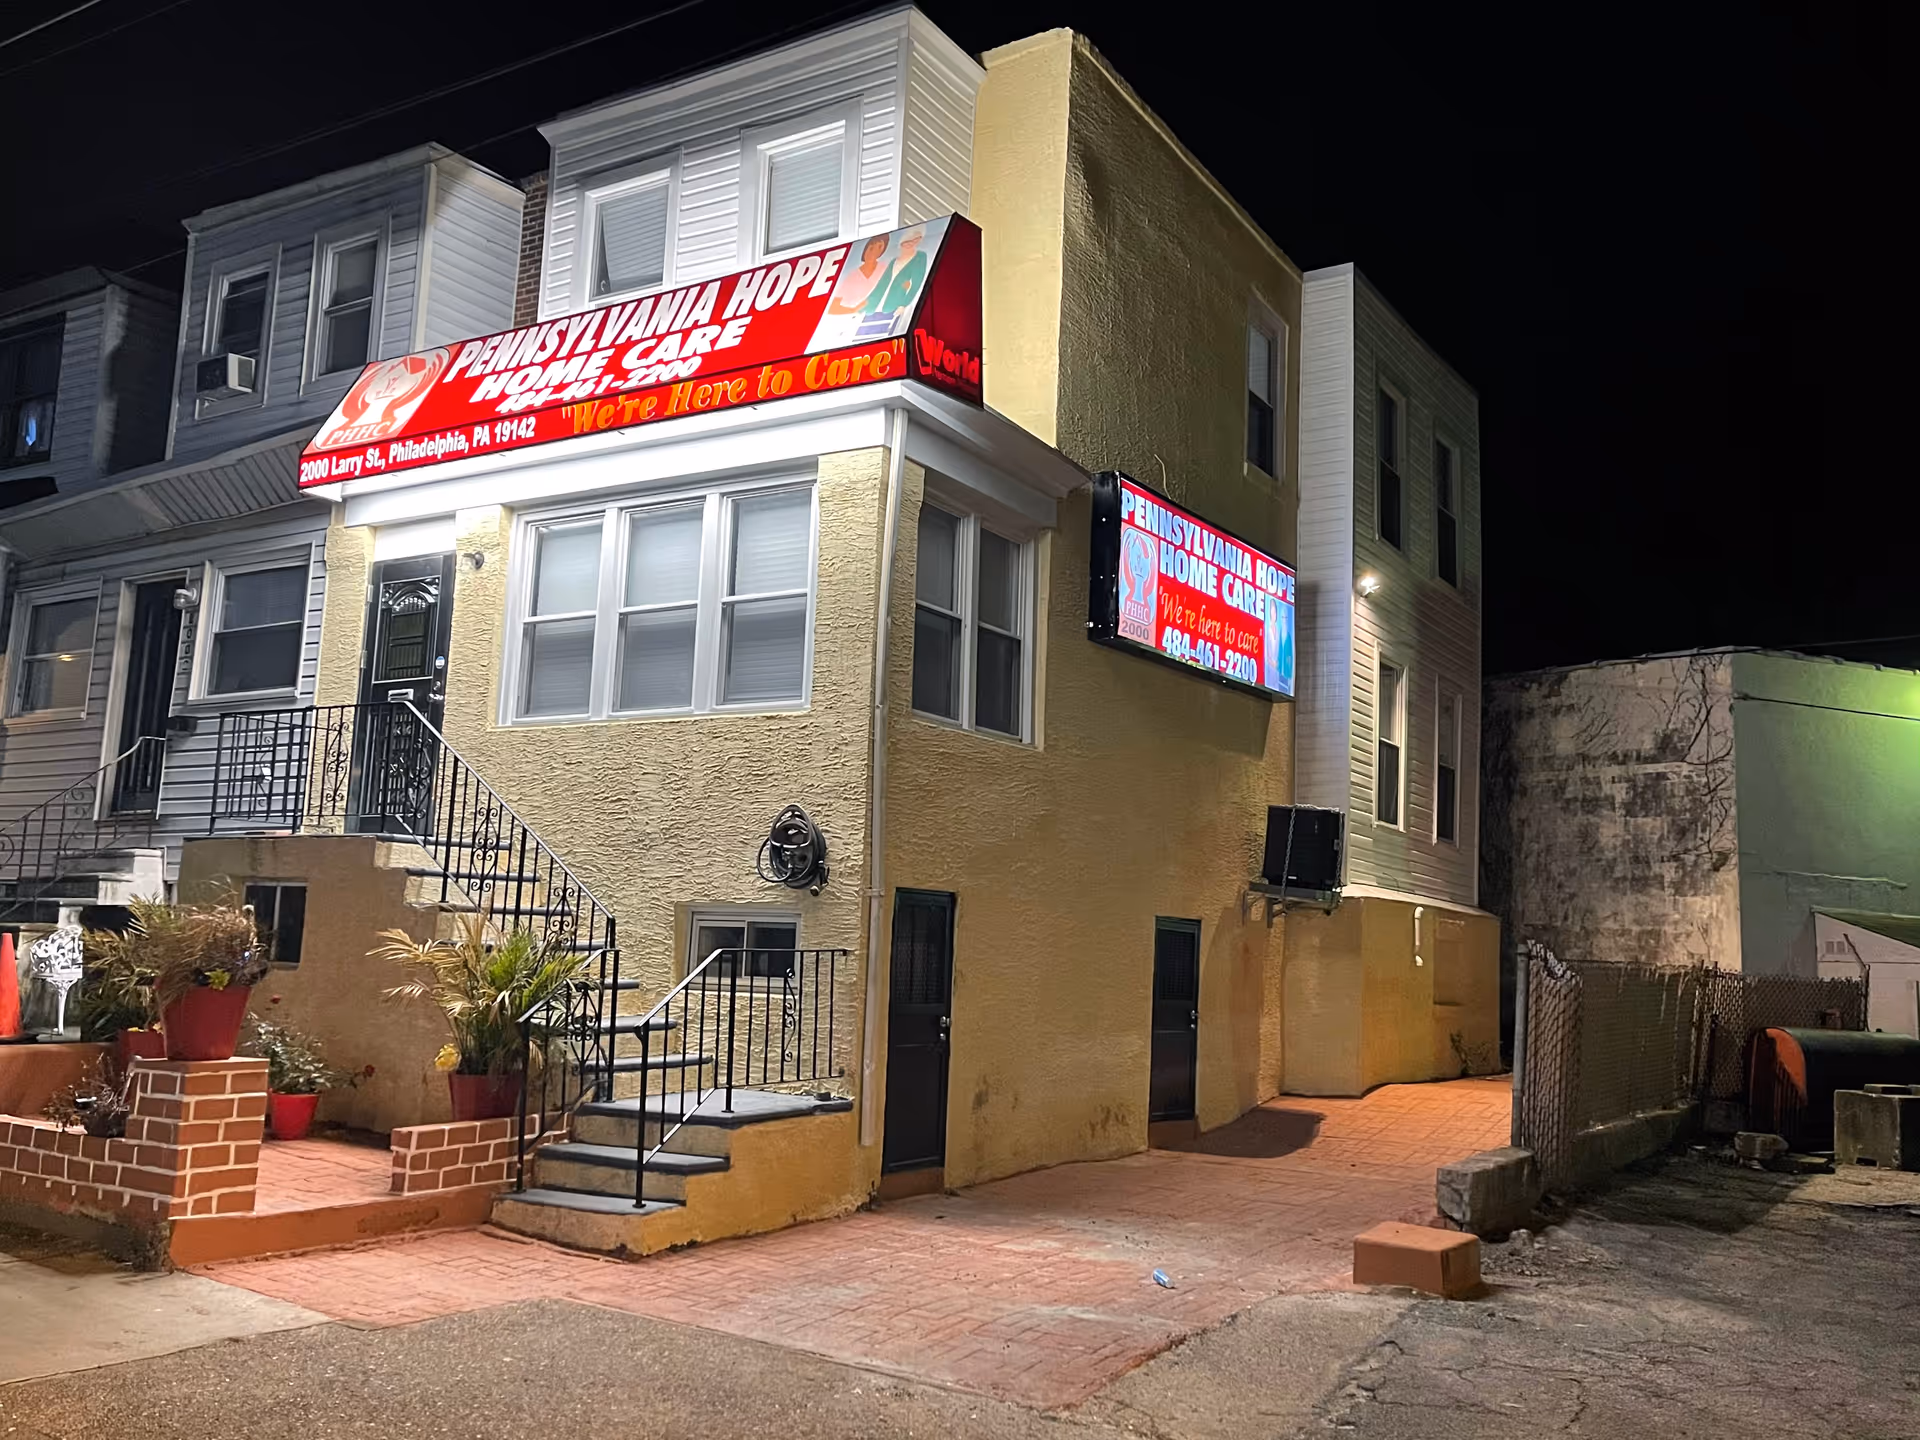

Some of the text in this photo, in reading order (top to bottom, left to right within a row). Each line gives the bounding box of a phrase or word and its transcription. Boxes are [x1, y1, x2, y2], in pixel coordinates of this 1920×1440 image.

[444, 247, 847, 383] PENNSYLVANIA HOPE
[469, 316, 753, 403] HOME CARE
[665, 380, 746, 416] Here
[757, 365, 793, 398] to
[300, 416, 536, 482] 2000 Larry St., Philadelphia, PA 19142
[328, 420, 390, 445] PHHC
[1121, 487, 1295, 601] PENNSYLVANIA HOPE
[1160, 539, 1265, 621] HOME CARE
[1121, 620, 1149, 640] 2000
[1125, 600, 1148, 621] PHHC
[1198, 605, 1221, 640] here
[1225, 621, 1235, 645] to
[1162, 626, 1257, 683] 484-461-2200
